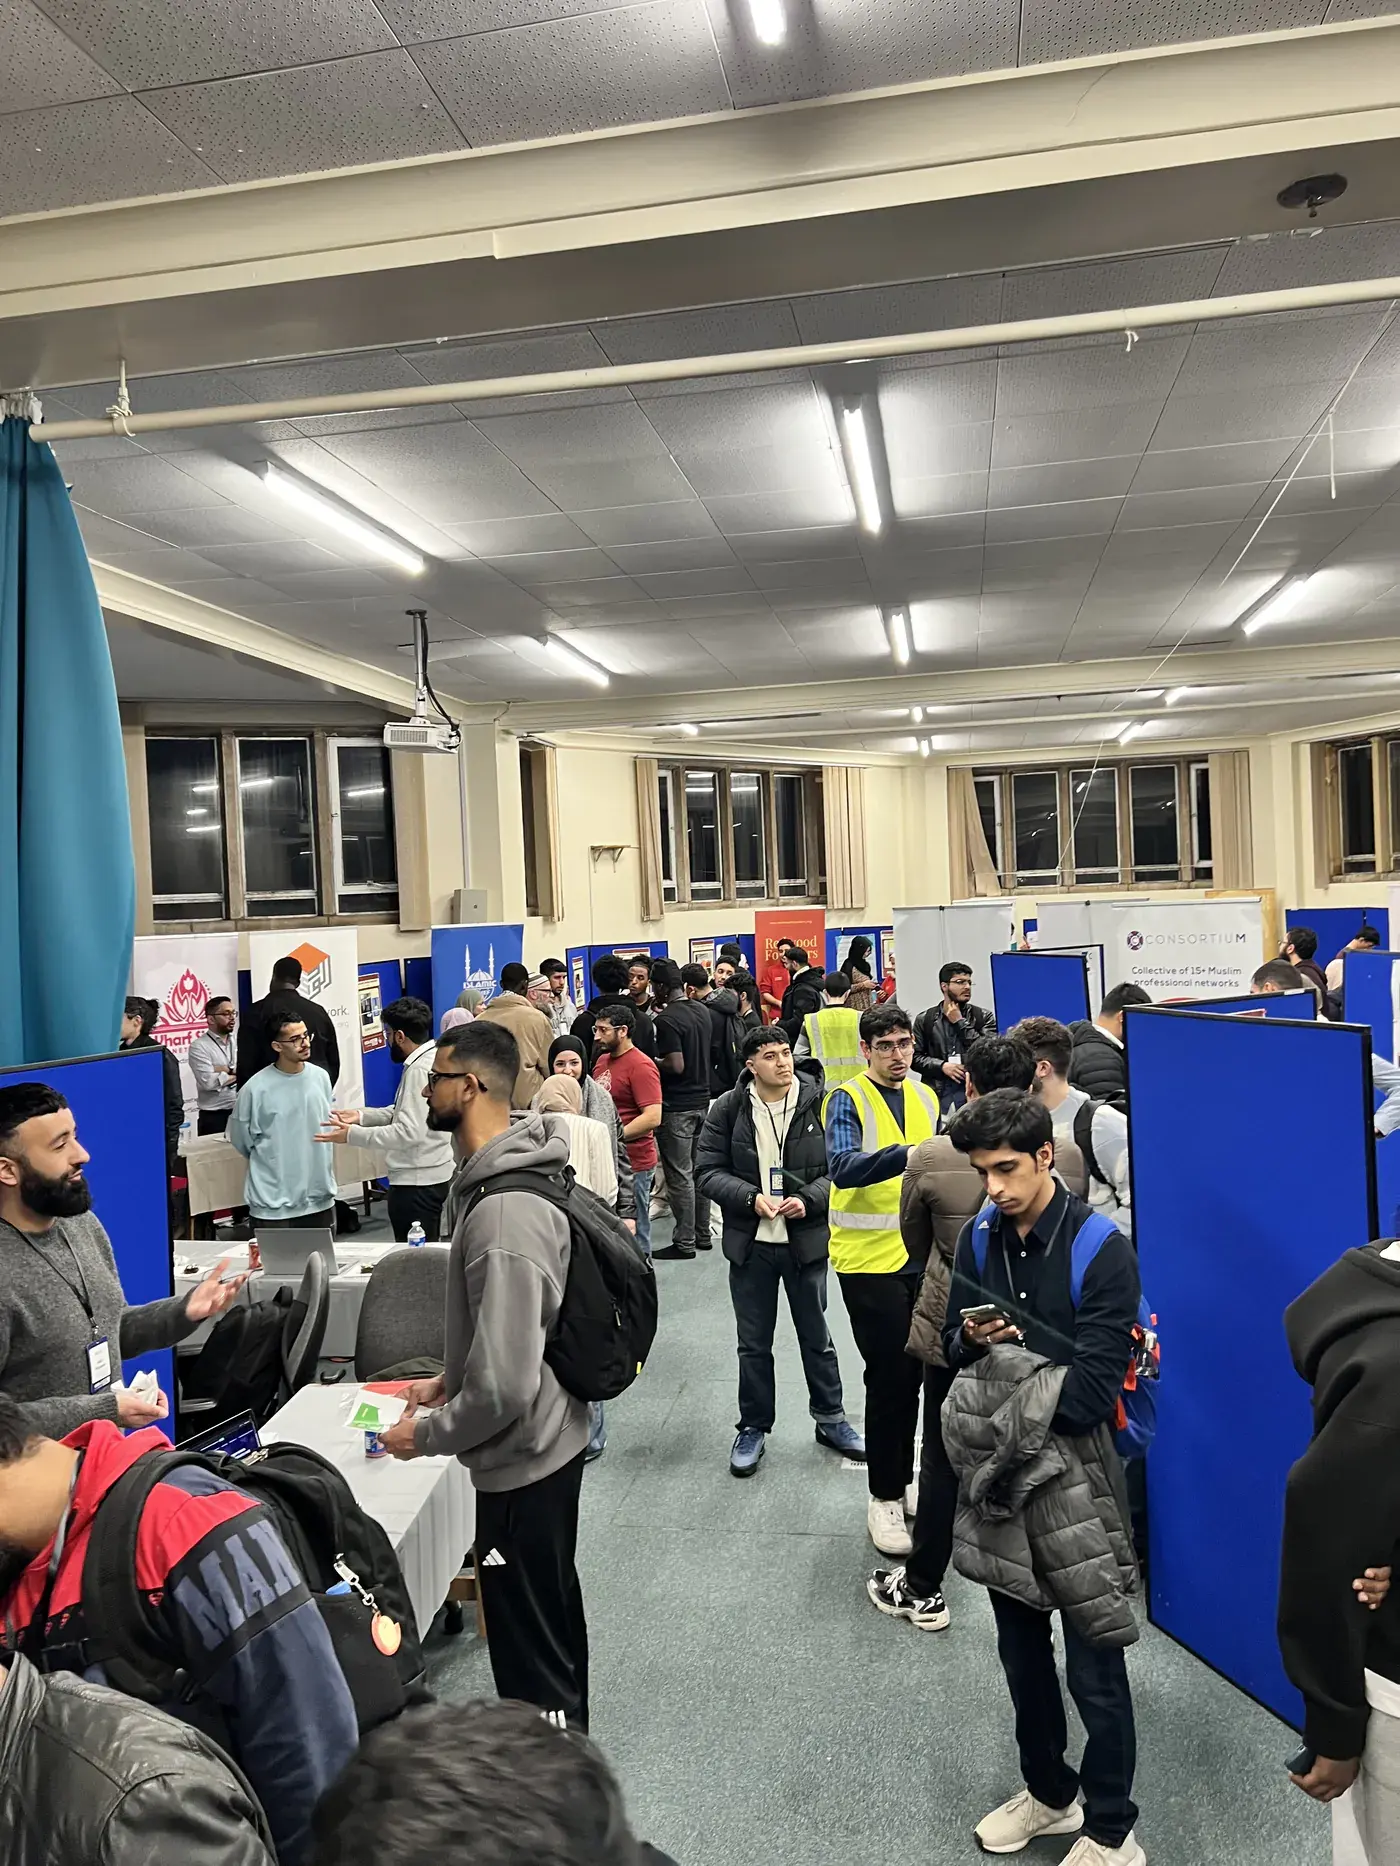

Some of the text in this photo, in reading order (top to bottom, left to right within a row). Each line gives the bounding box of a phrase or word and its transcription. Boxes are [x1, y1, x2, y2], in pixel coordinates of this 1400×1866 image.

[765, 935, 817, 949] Reood
[1145, 933, 1246, 944] CONSORTIUM
[1131, 966, 1242, 975] Collective of 15+ Muslim
[463, 980, 497, 989] ISLAMIC
[1134, 979, 1239, 987] professional networks
